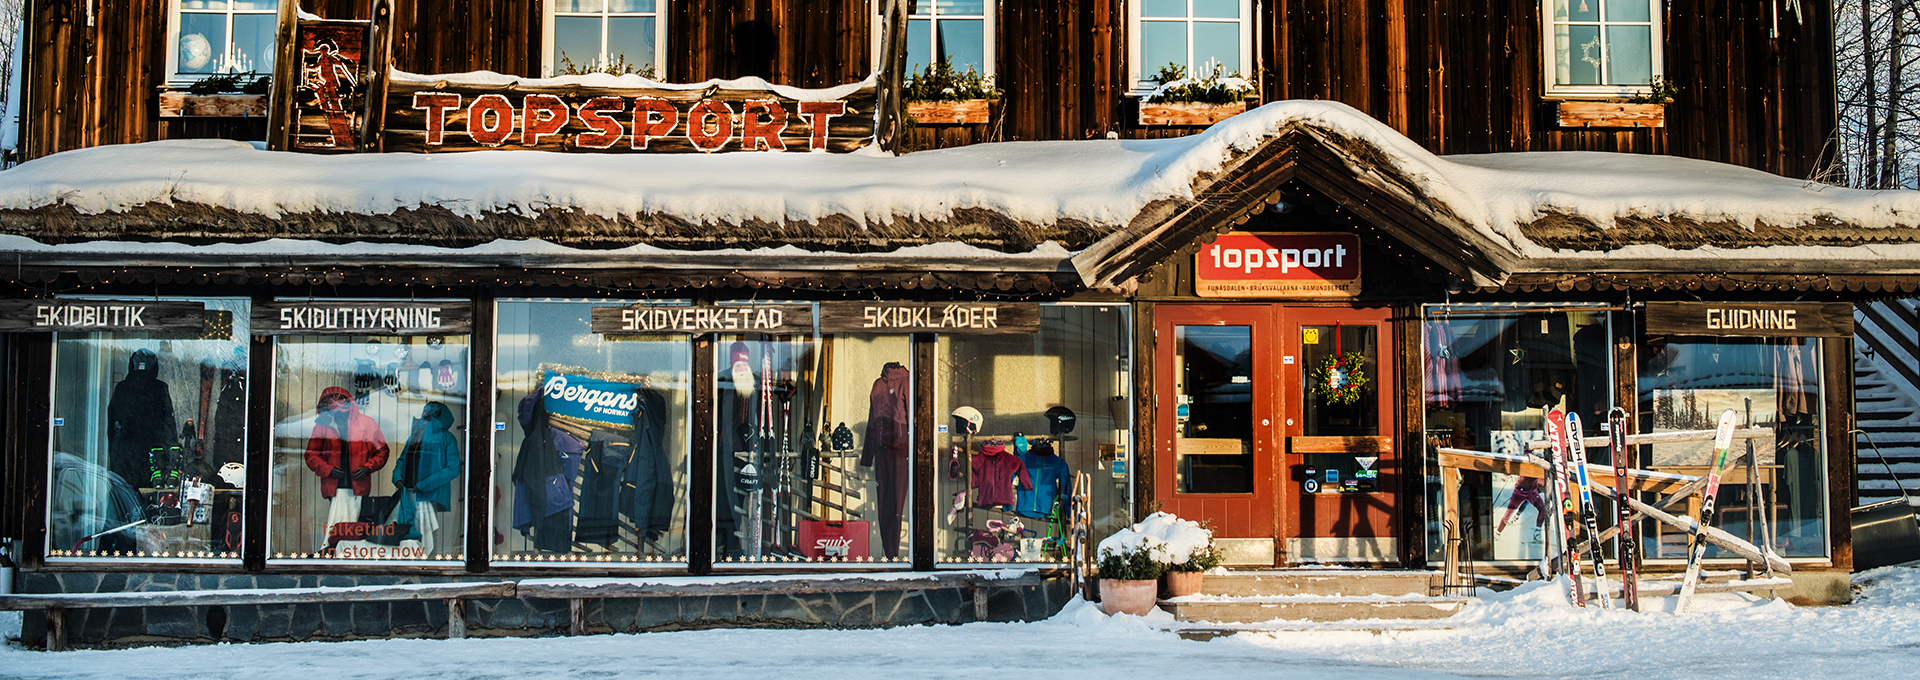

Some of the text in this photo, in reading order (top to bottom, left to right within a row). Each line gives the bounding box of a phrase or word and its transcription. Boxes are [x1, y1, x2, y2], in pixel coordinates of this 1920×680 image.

[412, 91, 846, 152] TOPSPORT
[1210, 244, 1346, 273] topsport
[36, 305, 145, 327] SKIDBUTIK
[280, 306, 442, 329] SKIDUTHYRNING
[621, 308, 783, 331] SKIDVERKSTAD
[863, 304, 997, 329] SKIDKLÄDER
[1706, 308, 1797, 330] GUIDNING
[543, 376, 638, 411] Bergans
[603, 407, 629, 417] NORWAY
[1570, 421, 1582, 461] HEAD
[1548, 418, 1566, 493] ATOMIC
[322, 521, 395, 536] falketind
[321, 543, 425, 558] in store now
